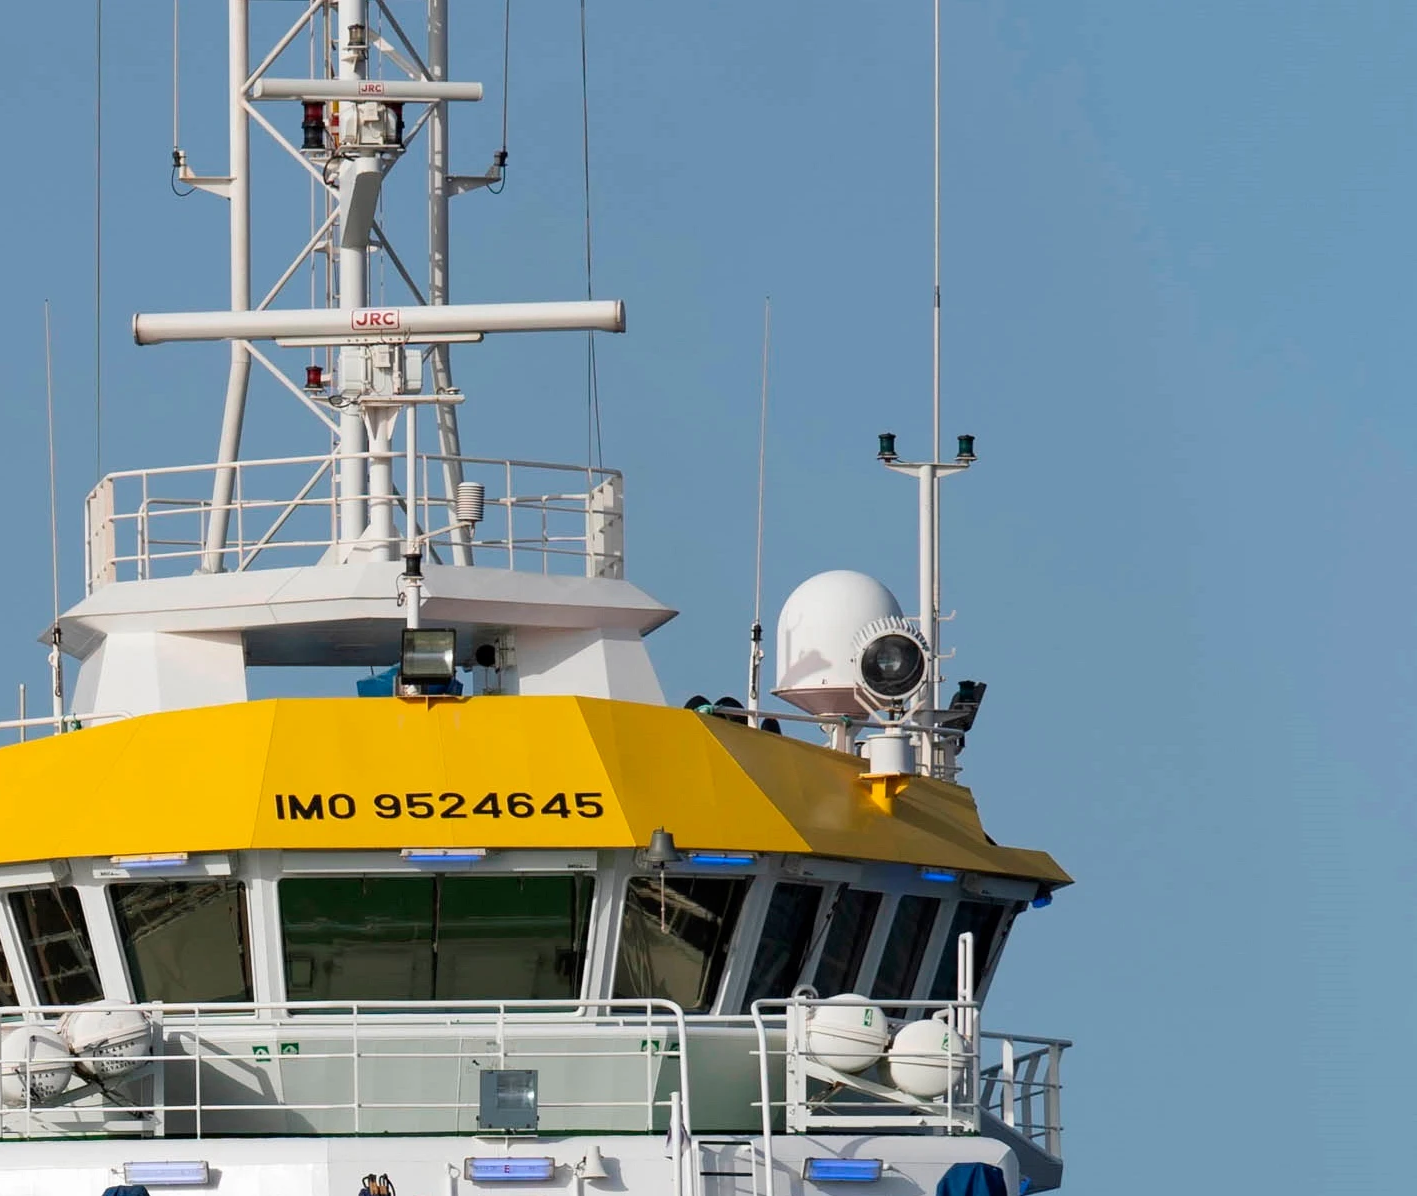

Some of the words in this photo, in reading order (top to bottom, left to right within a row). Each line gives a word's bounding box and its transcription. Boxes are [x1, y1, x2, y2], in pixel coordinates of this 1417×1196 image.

[361, 83, 382, 93] JRC
[355, 311, 396, 327] JRC
[274, 792, 356, 820] IMO
[373, 791, 605, 819] 9524645
